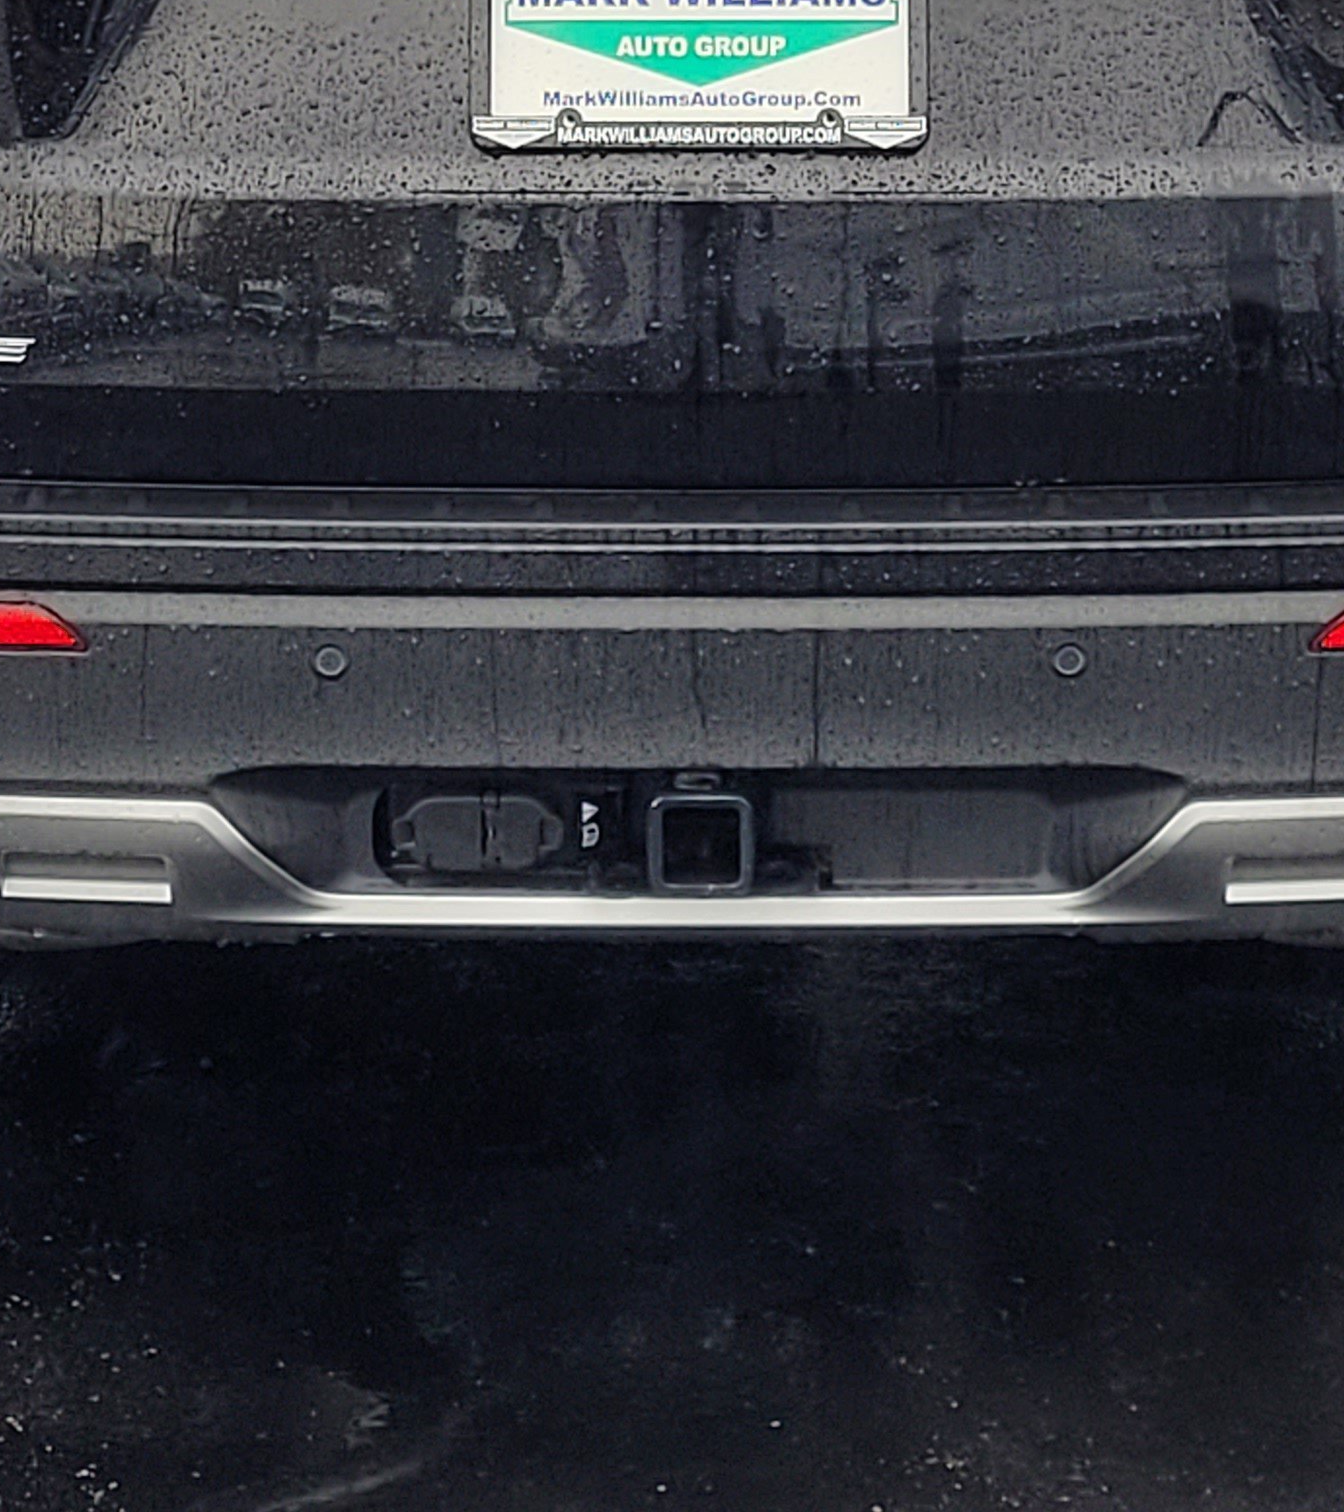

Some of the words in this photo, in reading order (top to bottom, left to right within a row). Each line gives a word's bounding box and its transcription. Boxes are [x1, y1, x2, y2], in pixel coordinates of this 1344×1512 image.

[616, 35, 688, 57] AUTO
[693, 35, 787, 57] GROUP
[543, 90, 862, 110] MarkWilliamsAutoGroup.Com
[557, 125, 842, 144] MARKWILLIAMSAUTOGROUP.COM
